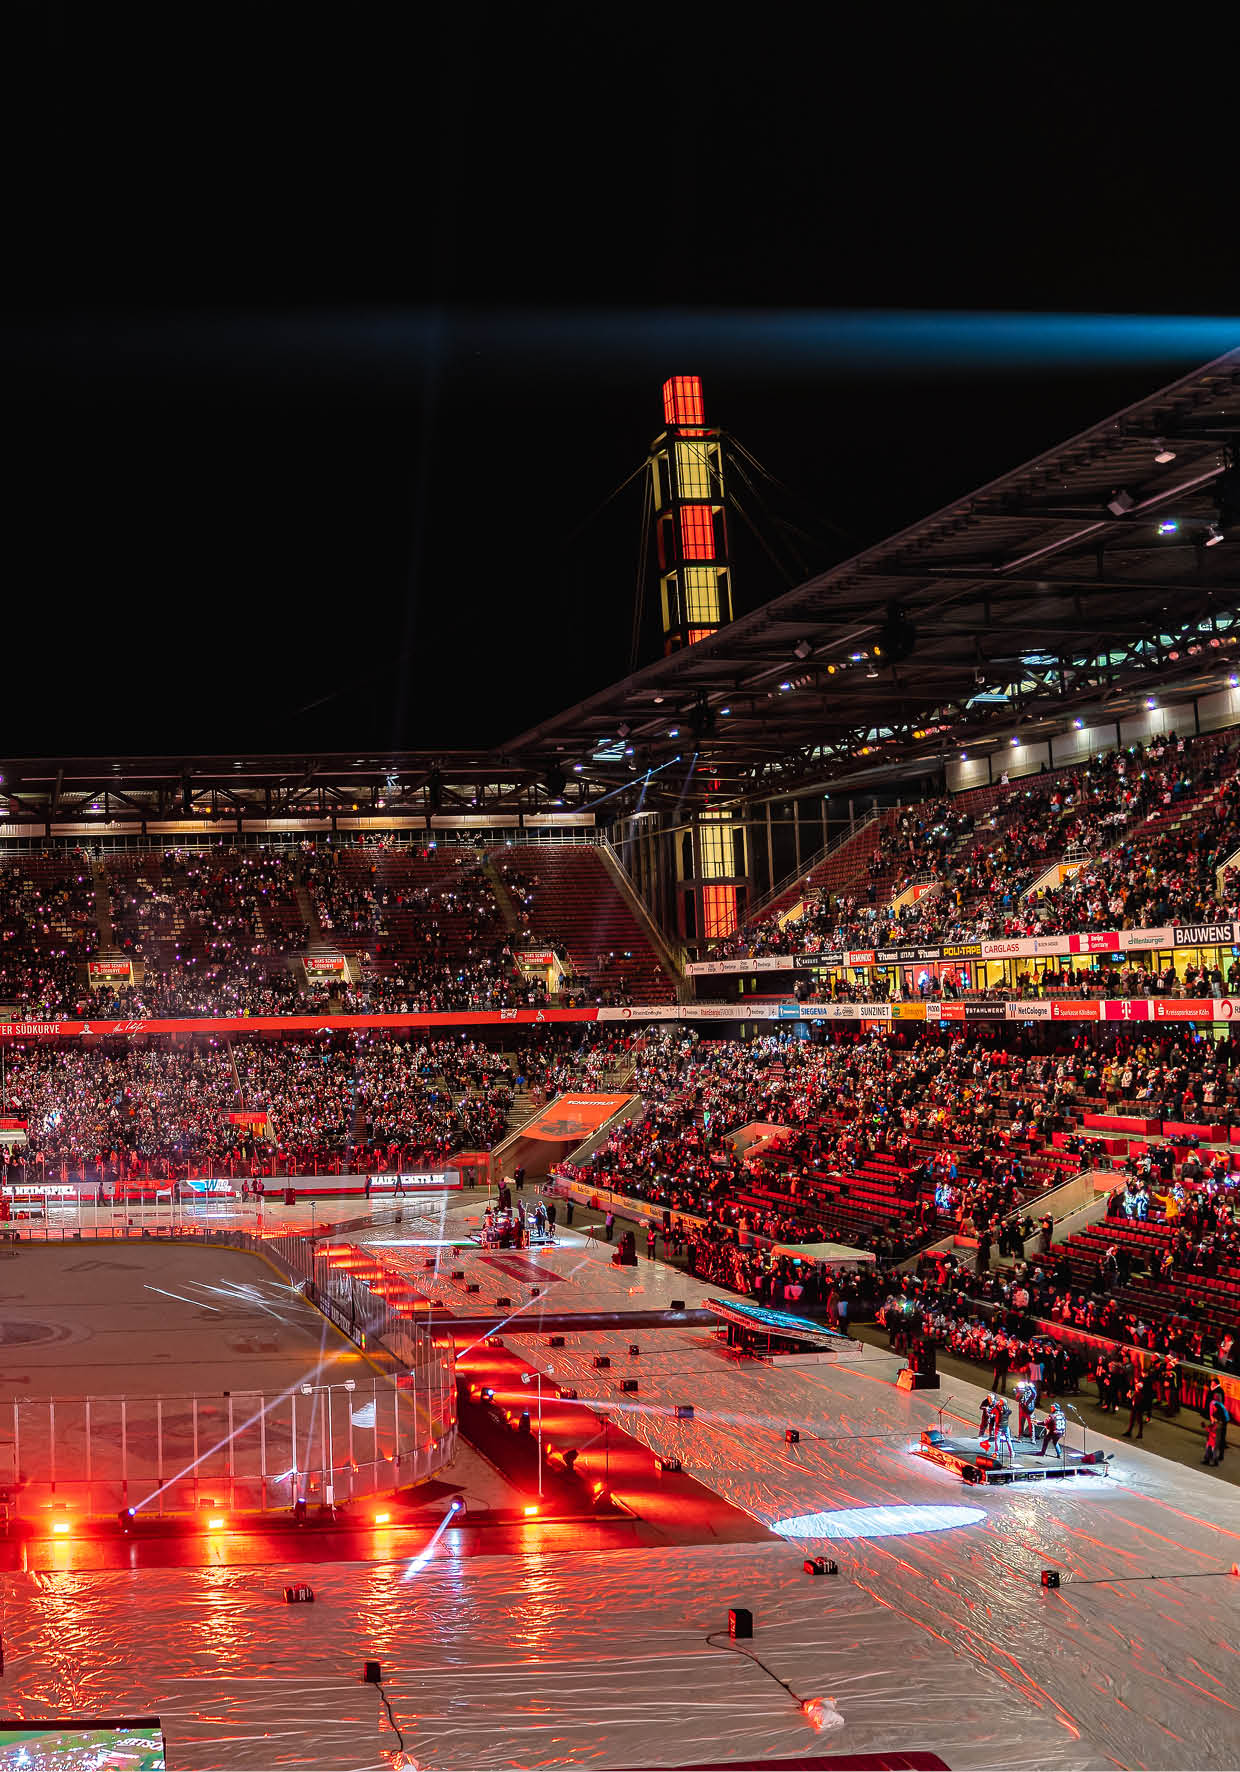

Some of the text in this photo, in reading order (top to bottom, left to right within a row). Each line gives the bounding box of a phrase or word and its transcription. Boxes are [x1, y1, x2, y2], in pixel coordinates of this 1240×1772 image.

[1176, 926, 1231, 944] BAUWENS
[943, 945, 981, 957] POLI-TAPE
[984, 943, 1020, 953] CARGLASS
[800, 1007, 827, 1016] SIEGENIA
[860, 1006, 889, 1016] SUNZINET
[1018, 1007, 1048, 1016] NetCologne
[1060, 1009, 1079, 1017] Sparkasse
[1199, 1008, 1210, 1016] Köln
[15, 1023, 60, 1035] SÜDKURVE
[13, 1185, 76, 1196] HEIMSPIEL
